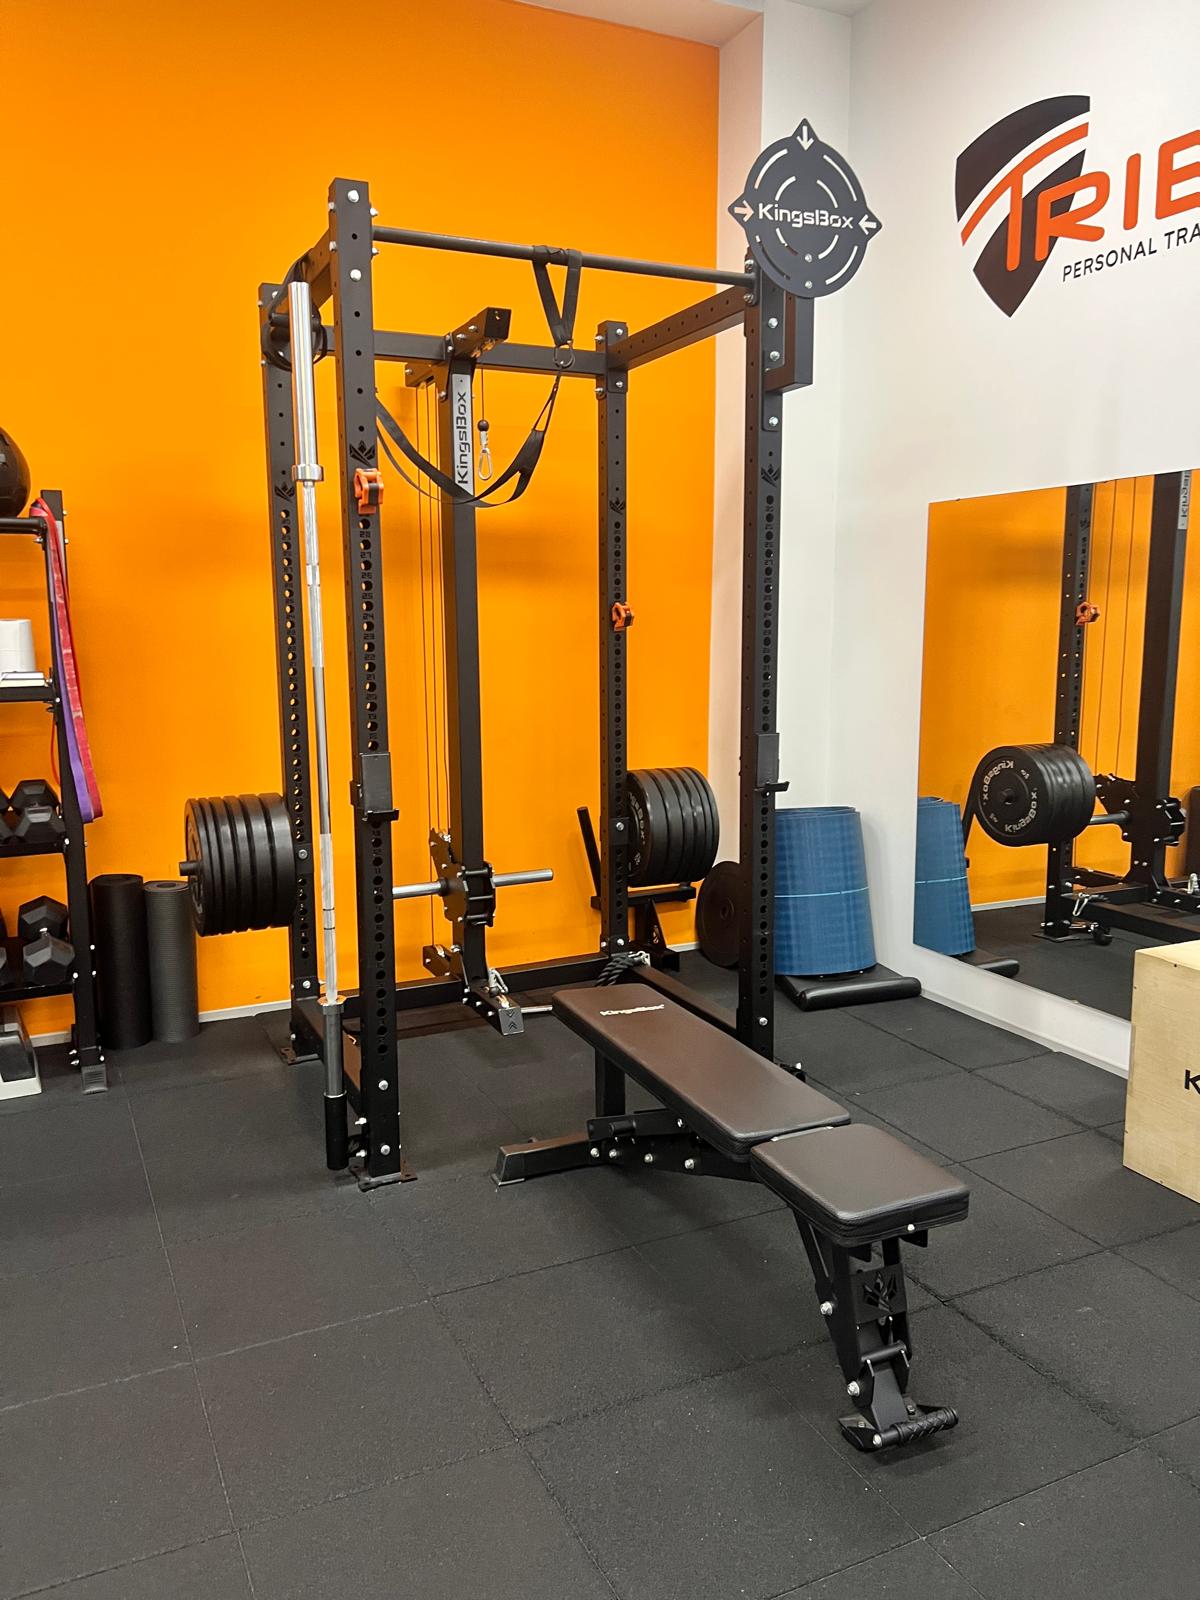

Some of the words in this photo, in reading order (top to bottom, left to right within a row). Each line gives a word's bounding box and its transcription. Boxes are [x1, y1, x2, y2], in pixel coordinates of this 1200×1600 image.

[758, 202, 854, 230] KingsBox
[1062, 237, 1158, 282] PERSONAL
[456, 391, 471, 484] KingsBox
